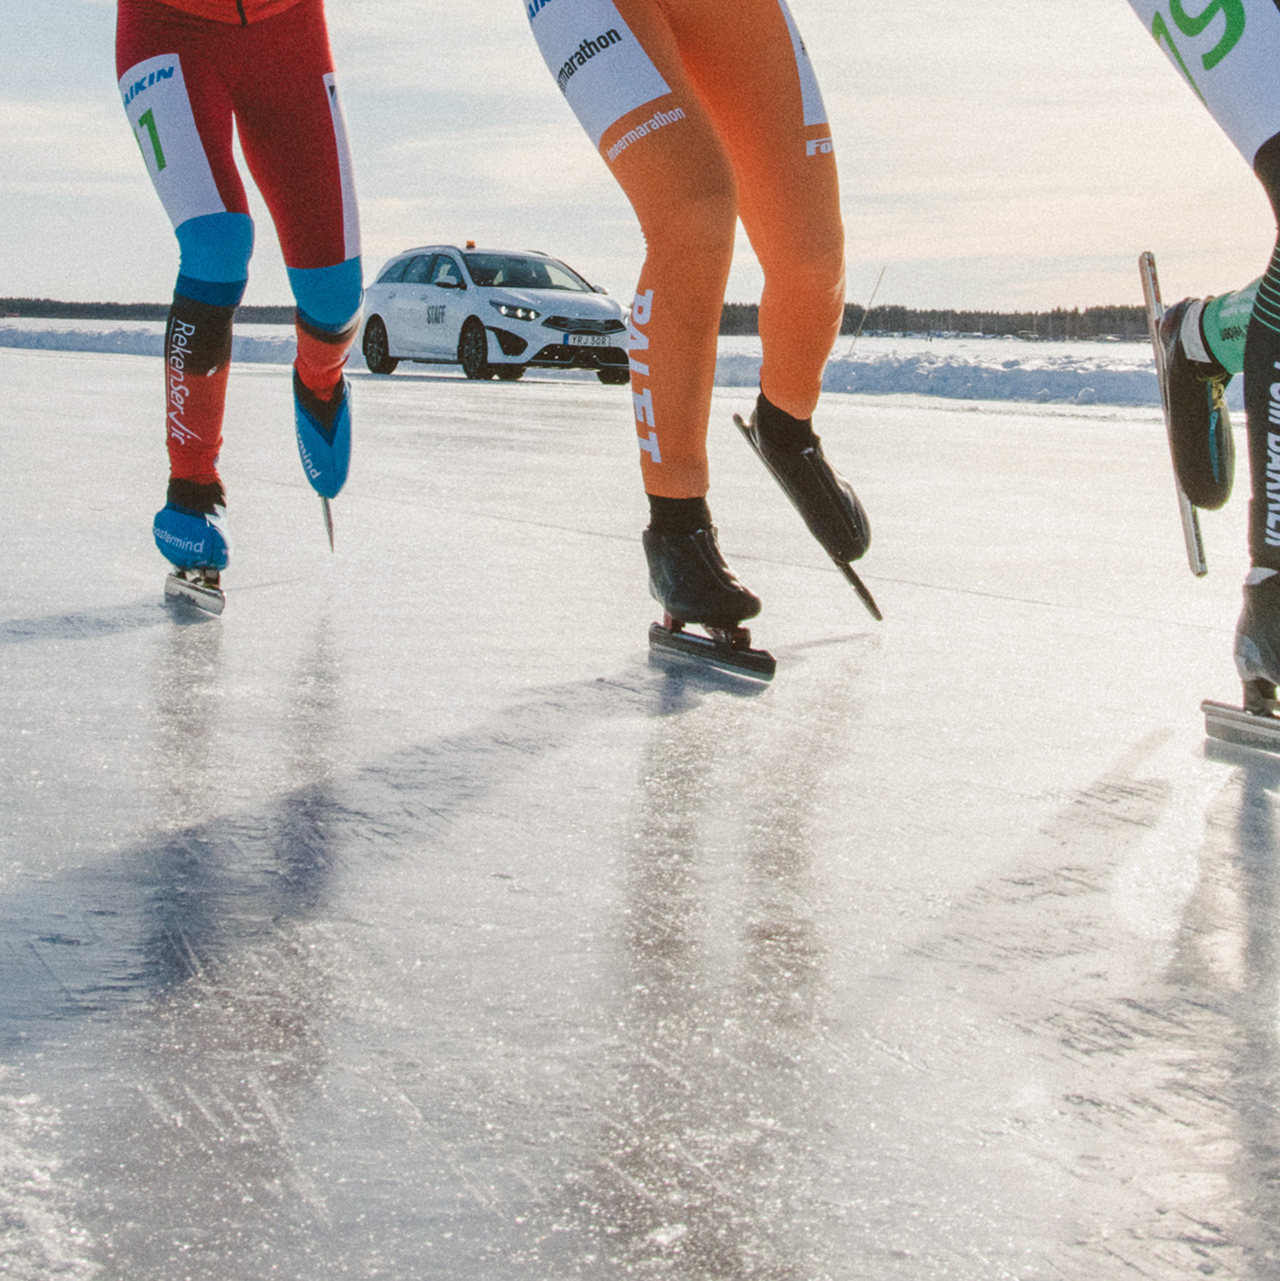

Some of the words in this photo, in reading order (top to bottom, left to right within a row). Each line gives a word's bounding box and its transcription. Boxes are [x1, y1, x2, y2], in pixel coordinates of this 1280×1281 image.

[426, 305, 447, 325] STAFF
[571, 336, 590, 345] YRJ
[629, 289, 662, 463] PALET
